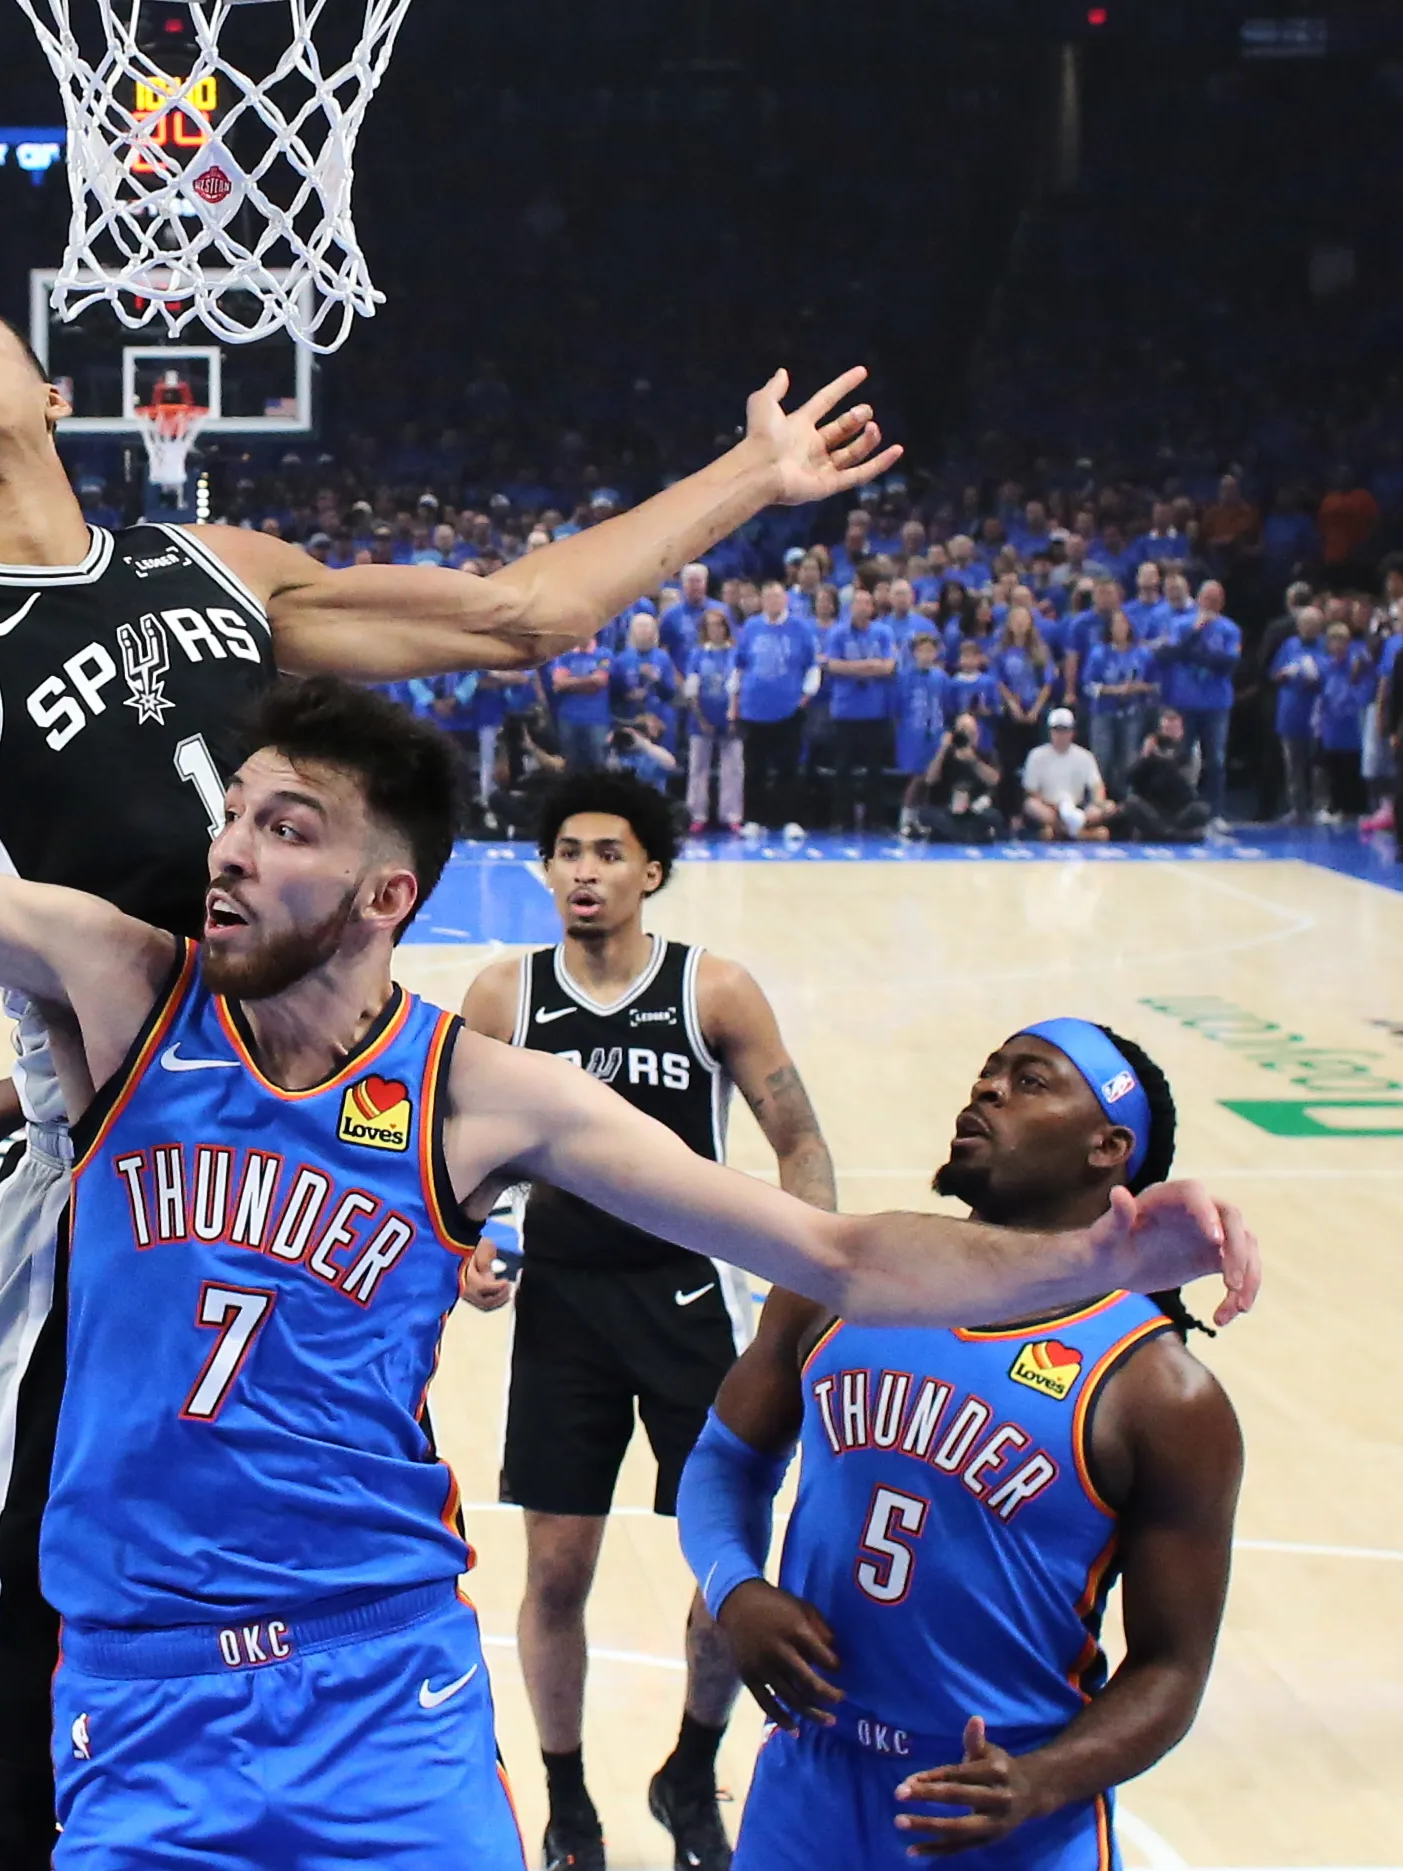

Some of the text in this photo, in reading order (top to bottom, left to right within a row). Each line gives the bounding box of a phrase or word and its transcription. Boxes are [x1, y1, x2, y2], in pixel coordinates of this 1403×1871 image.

[26, 607, 261, 751] SPURS
[172, 732, 228, 841] 1
[114, 1143, 417, 1309] THUNDER
[178, 1279, 278, 1421] 7
[812, 1368, 1060, 1525] THUNDER
[853, 1482, 931, 1607] 5
[218, 1619, 291, 1667] OKC
[857, 1718, 910, 1755] OKC
